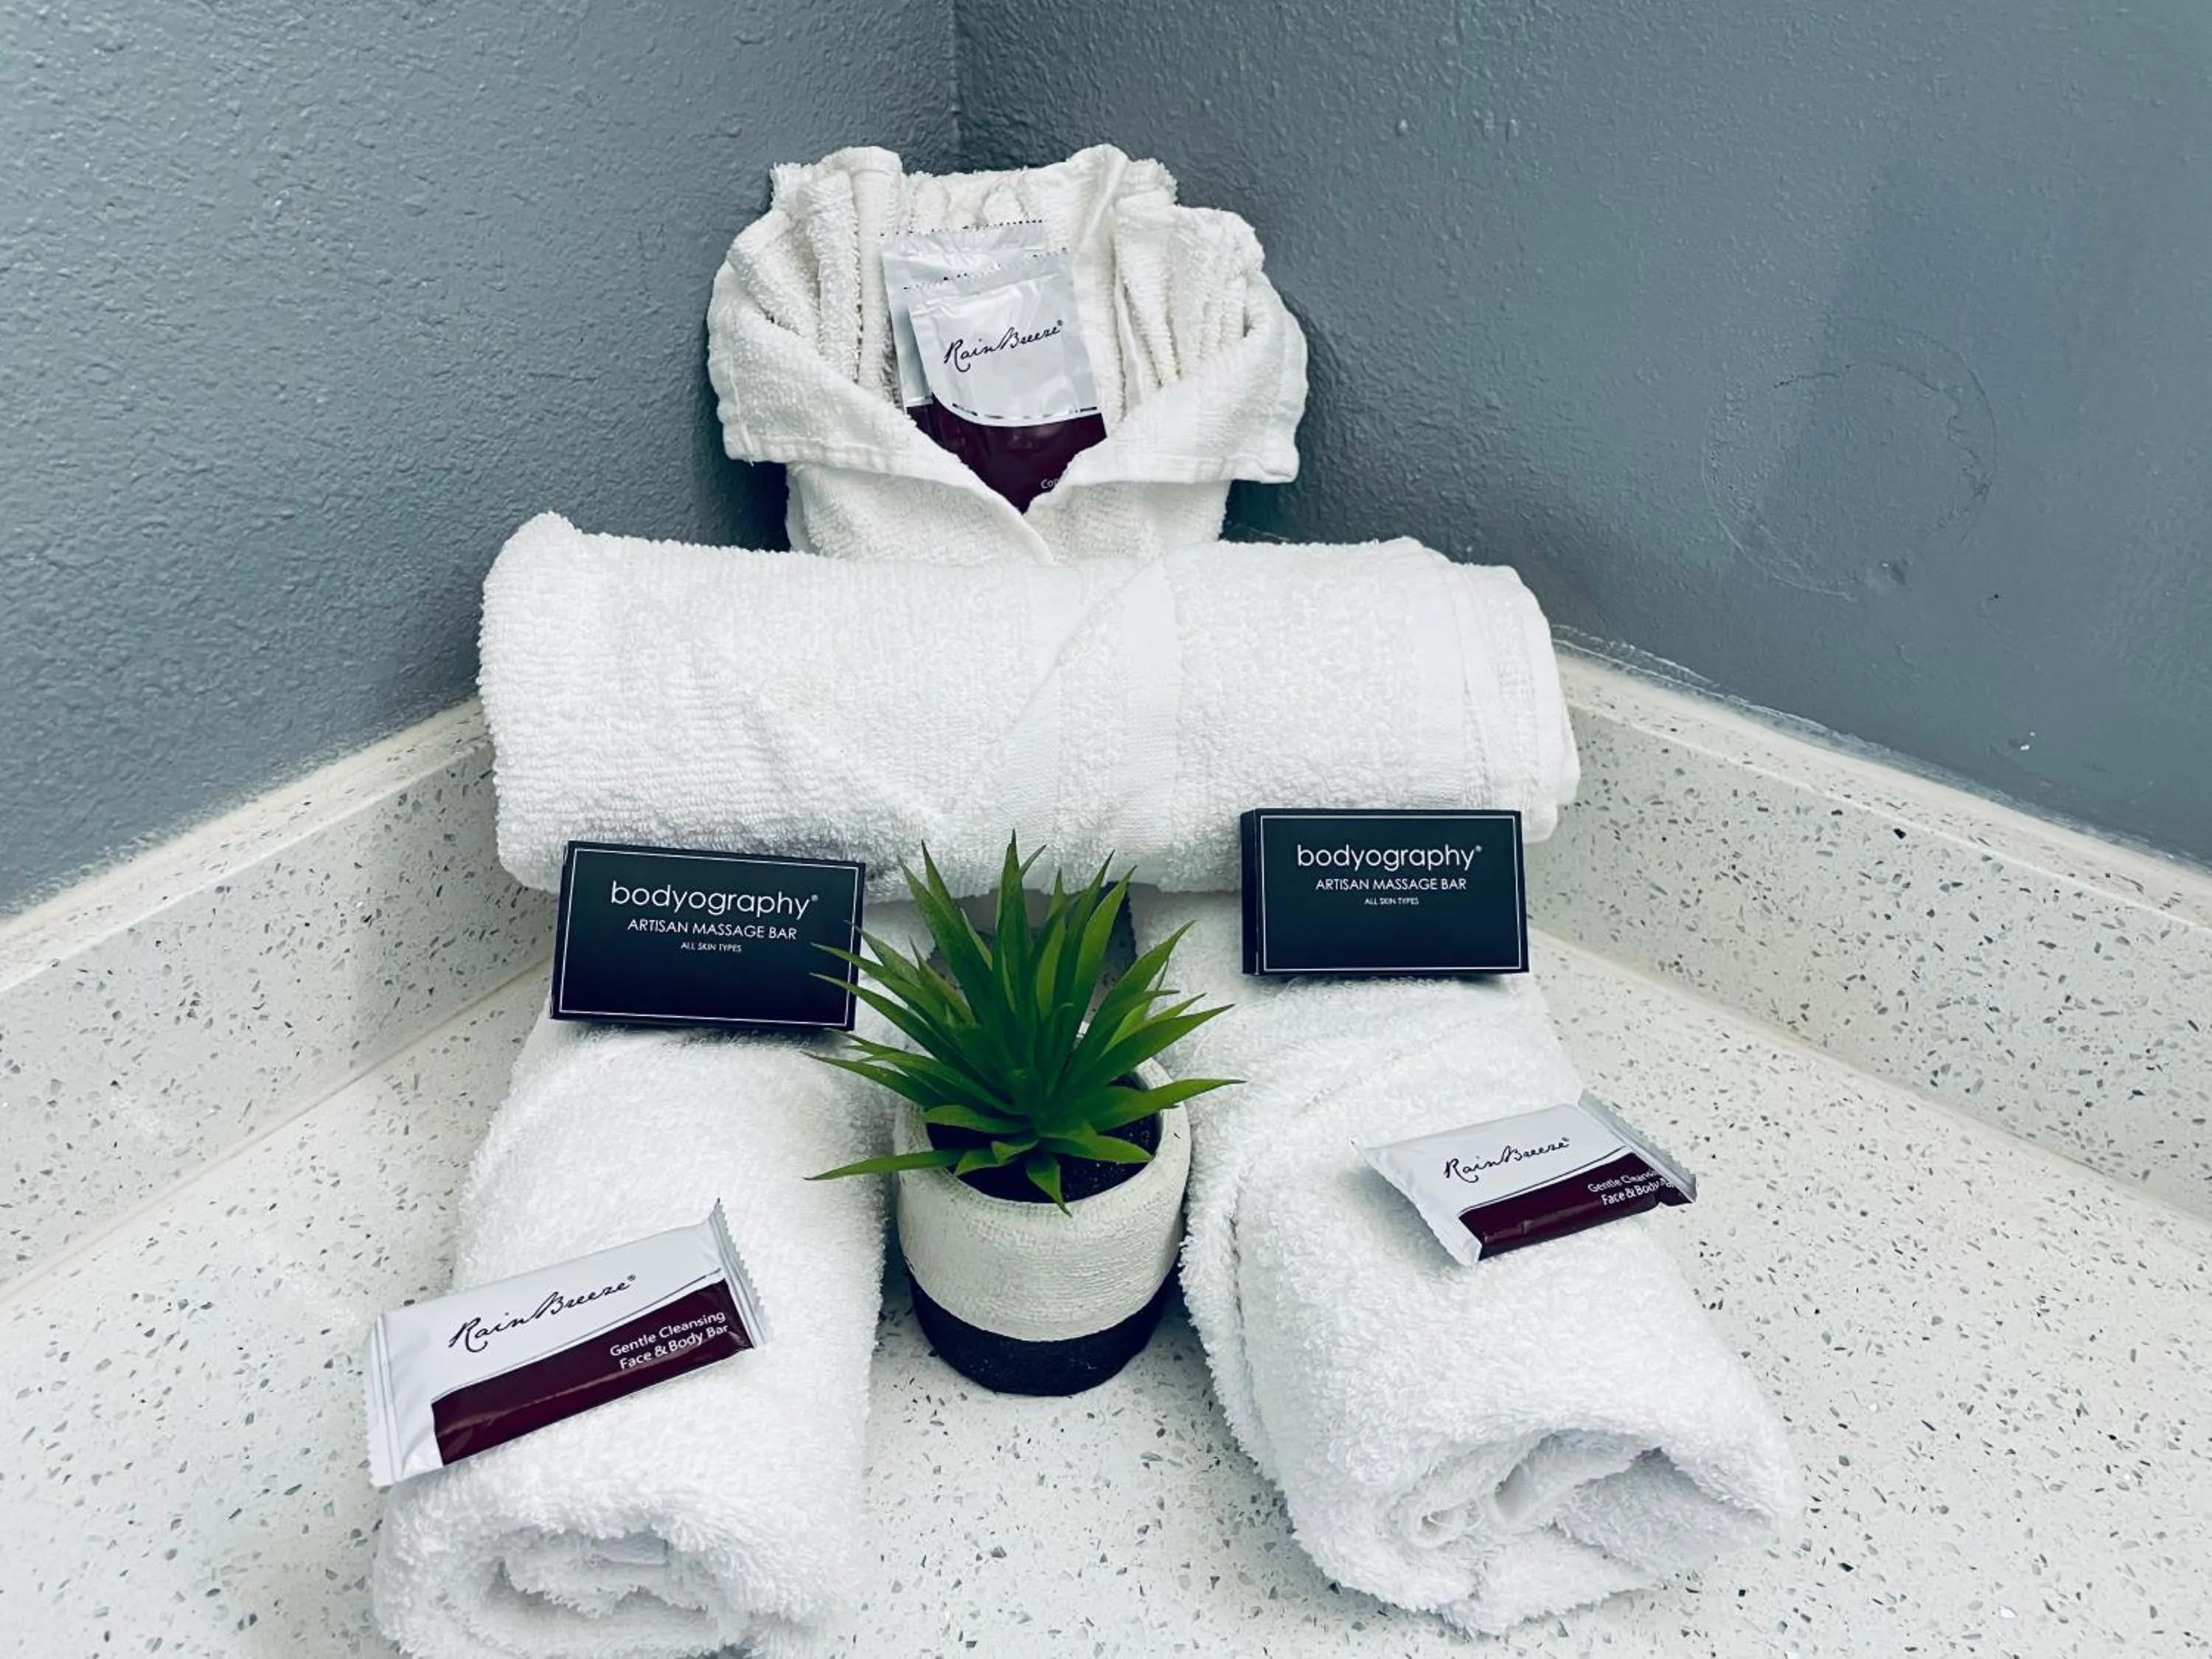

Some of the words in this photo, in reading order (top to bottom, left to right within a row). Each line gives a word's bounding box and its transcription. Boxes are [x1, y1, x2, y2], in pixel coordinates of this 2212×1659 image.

[1297, 844, 1475, 872] bodyography
[1315, 878, 1370, 891] ARTISAN
[1372, 878, 1438, 891] MASSAGE
[1441, 878, 1467, 891] BAR
[611, 880, 810, 921] bodyography
[1364, 897, 1377, 905] ALL
[1380, 897, 1396, 905] SKIN
[1398, 897, 1419, 905] TYPES
[627, 919, 689, 933] ARTISAN
[692, 922, 765, 939] MASSAGE
[768, 926, 798, 940] BAR
[681, 942, 695, 950] ALL
[697, 942, 717, 951] SKIN
[719, 943, 742, 953] TYPES
[1587, 1178, 1622, 1192] Gentle
[1601, 1191, 1626, 1206] Face
[1625, 1188, 1636, 1198] &
[610, 1334, 657, 1357] Gentle
[658, 1312, 726, 1339] Cleansing
[619, 1352, 653, 1369] Face
[654, 1345, 667, 1357] &
[668, 1332, 703, 1352] Body
[706, 1324, 728, 1338] Bar
